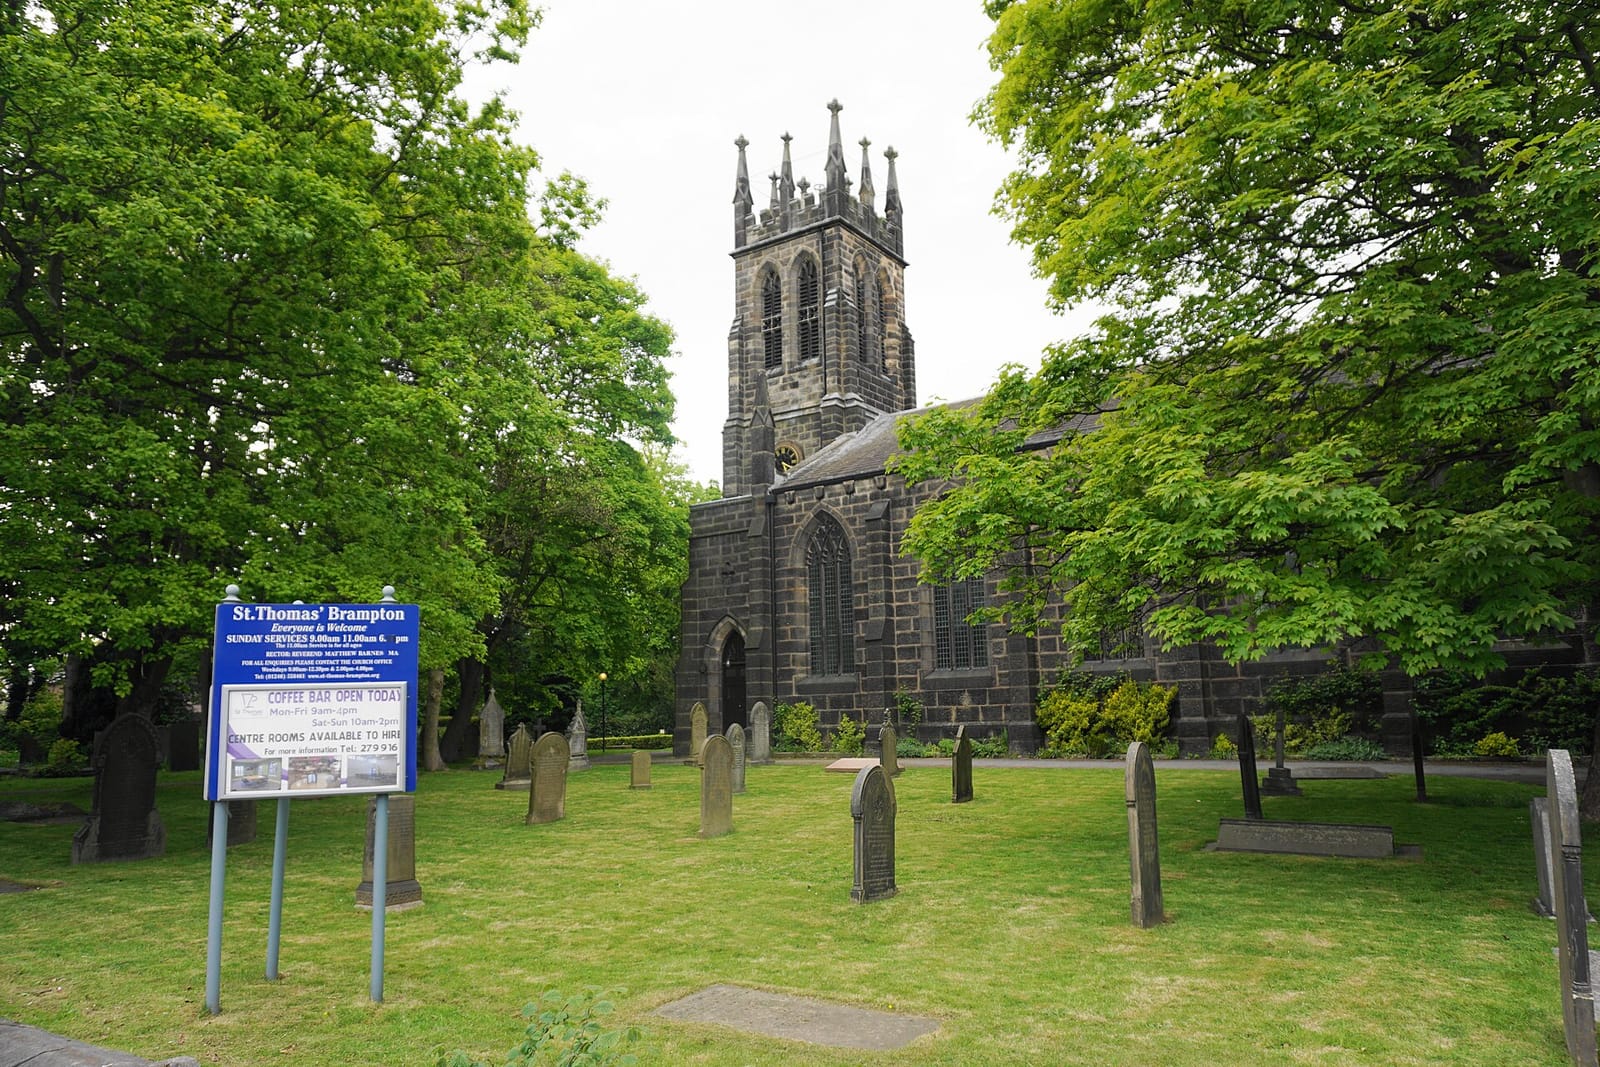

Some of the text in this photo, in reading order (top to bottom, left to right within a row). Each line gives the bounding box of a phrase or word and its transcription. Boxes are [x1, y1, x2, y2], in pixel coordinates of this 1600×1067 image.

[328, 606, 405, 624] Brampton
[271, 623, 367, 634] Everyone is Welcome
[226, 634, 263, 643] SUNDAY
[264, 634, 308, 643] SERVICES
[309, 634, 340, 643] 9.00am
[342, 634, 377, 642] 11.00am
[268, 689, 400, 704] COFFEE BAR OPEN TODAY
[270, 707, 308, 716] Mon-Fri
[311, 706, 357, 716] 9am-4pm
[312, 717, 399, 727] Sat-Sun 10am-2pm
[228, 730, 400, 744] CENTRE ROOMS AVAILABLE TO HIRE
[298, 746, 337, 754] information
[340, 744, 357, 752] Tel:
